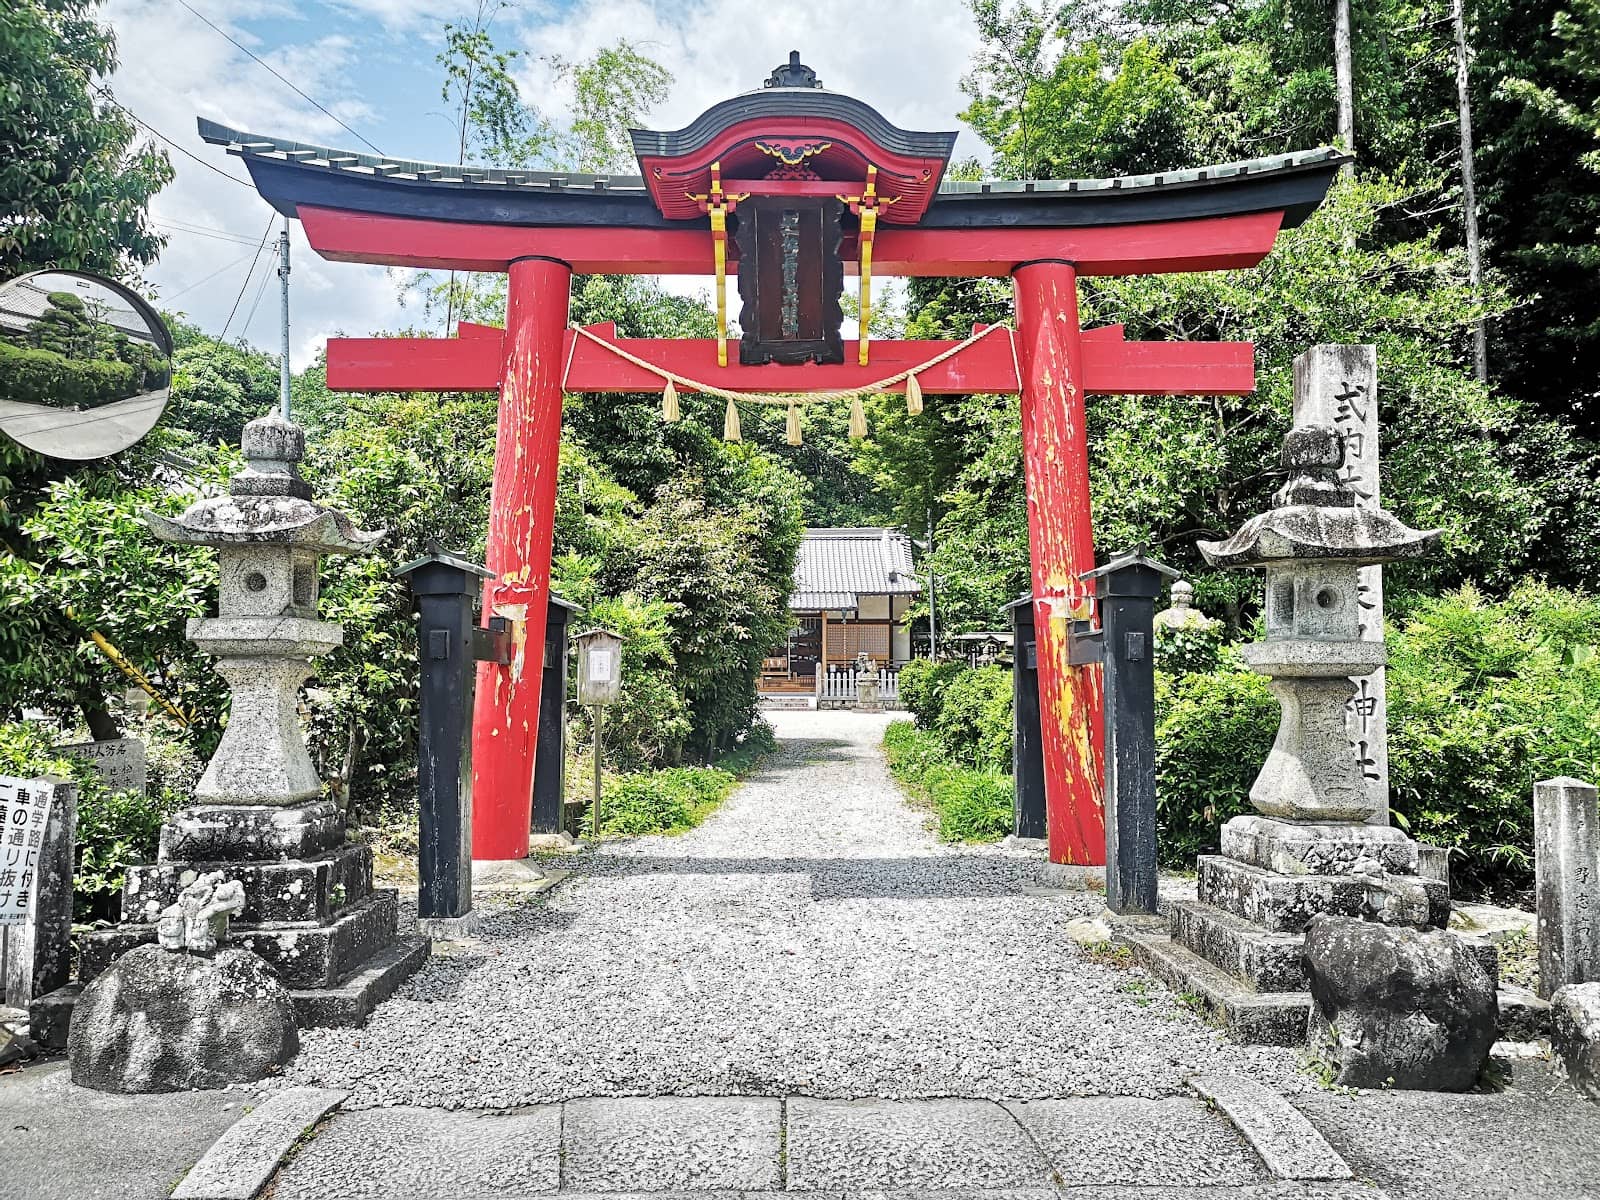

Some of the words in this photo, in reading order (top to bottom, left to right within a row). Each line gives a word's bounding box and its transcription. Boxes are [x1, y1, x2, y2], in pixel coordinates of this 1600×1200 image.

[16, 789, 49, 908] 通学路に付き
